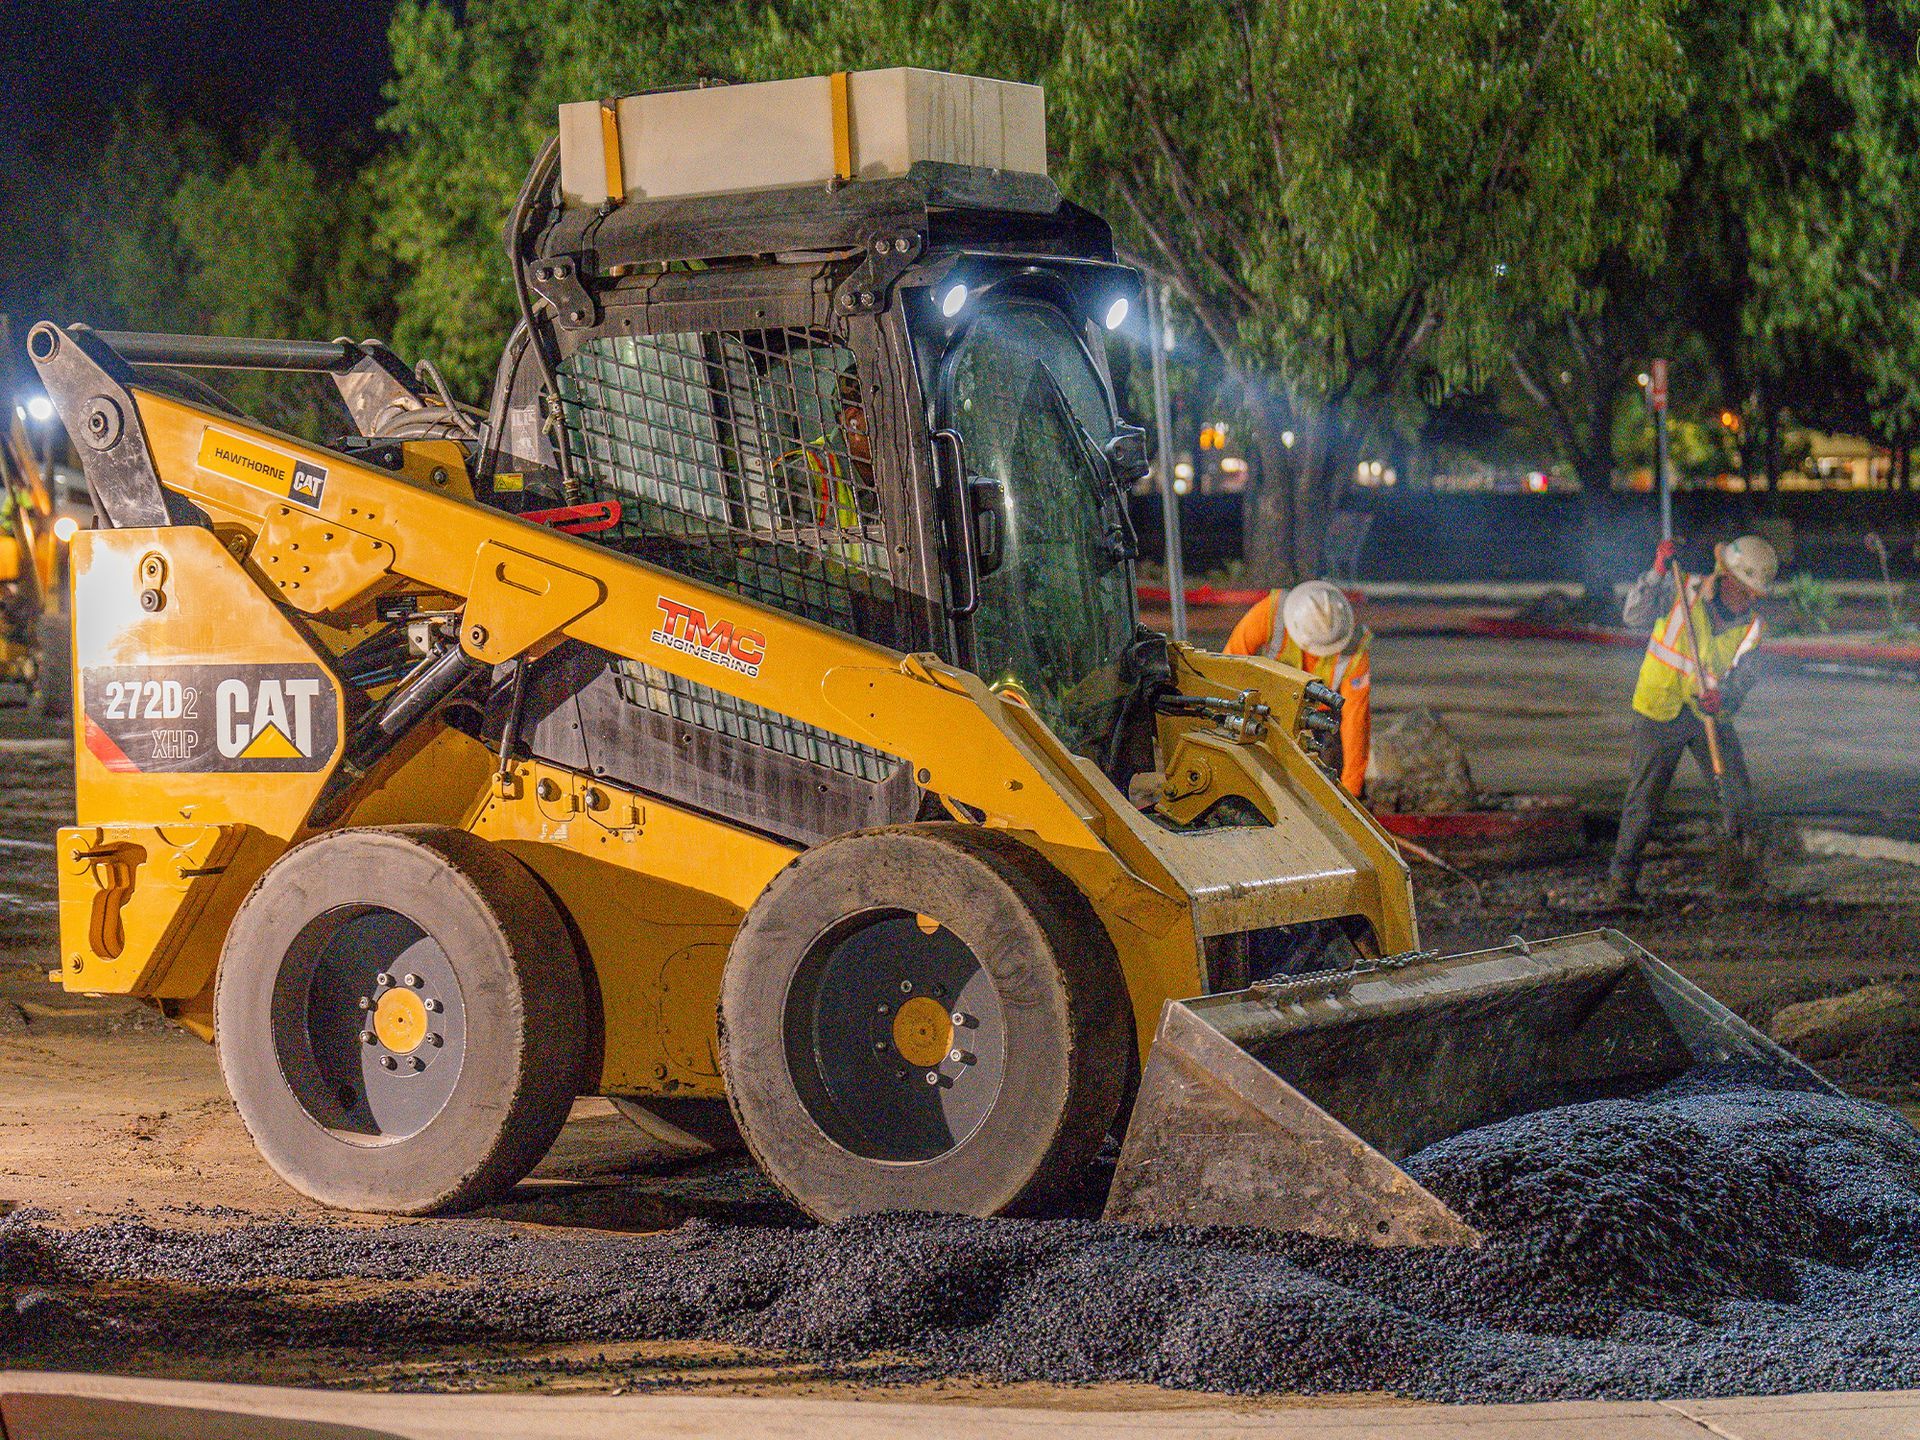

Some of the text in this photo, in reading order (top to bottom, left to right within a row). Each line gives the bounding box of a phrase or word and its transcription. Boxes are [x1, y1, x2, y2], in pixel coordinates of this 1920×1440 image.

[215, 448, 286, 481] HAWTHORNE
[293, 471, 324, 498] CAT
[657, 596, 766, 666] TMC
[651, 630, 759, 677] ENGINEERING
[215, 679, 319, 758] CAT
[151, 730, 198, 759] XHP
